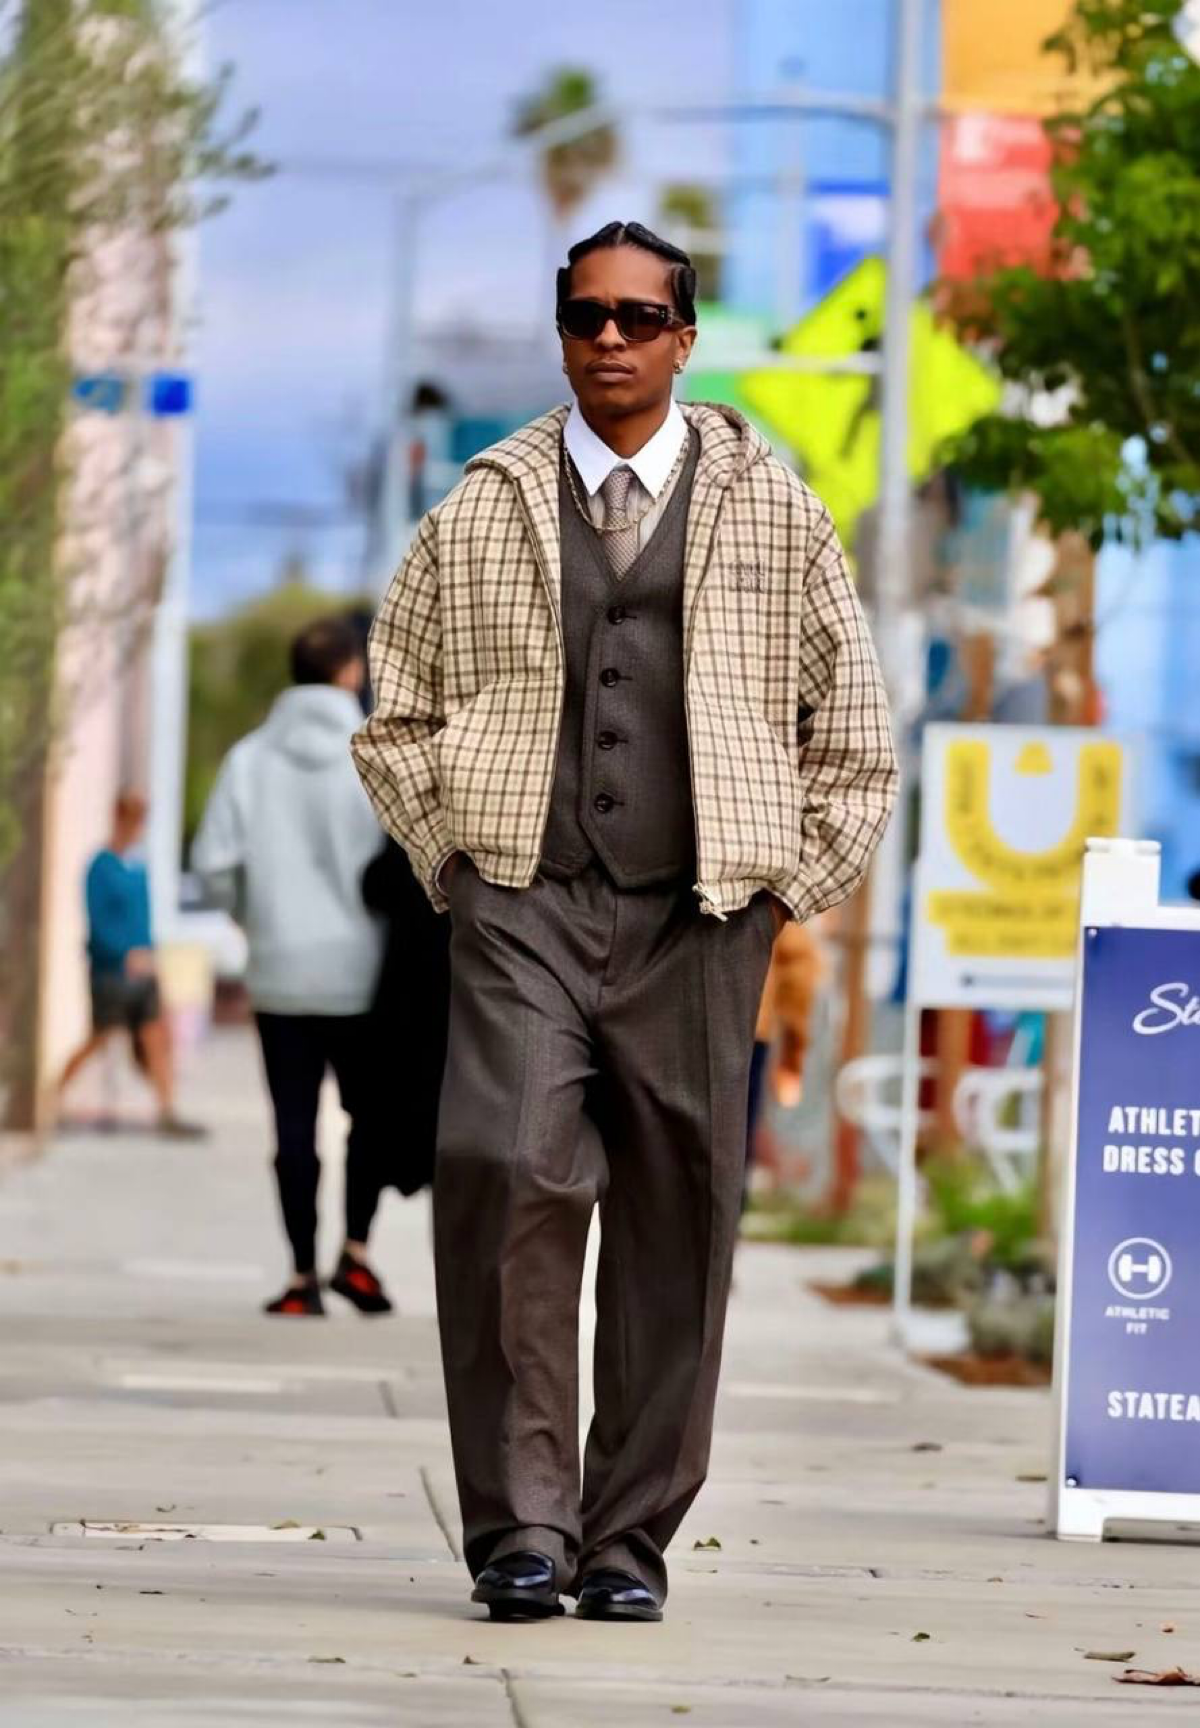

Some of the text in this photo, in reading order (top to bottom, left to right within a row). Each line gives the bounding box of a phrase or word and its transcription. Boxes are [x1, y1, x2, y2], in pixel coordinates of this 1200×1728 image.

[1108, 1106, 1200, 1137] ATHLET
[1103, 1145, 1185, 1176] DRESS
[1105, 1305, 1169, 1320] ATHLETIC
[1126, 1322, 1148, 1335] FIT
[1107, 1391, 1200, 1421] STATEA
